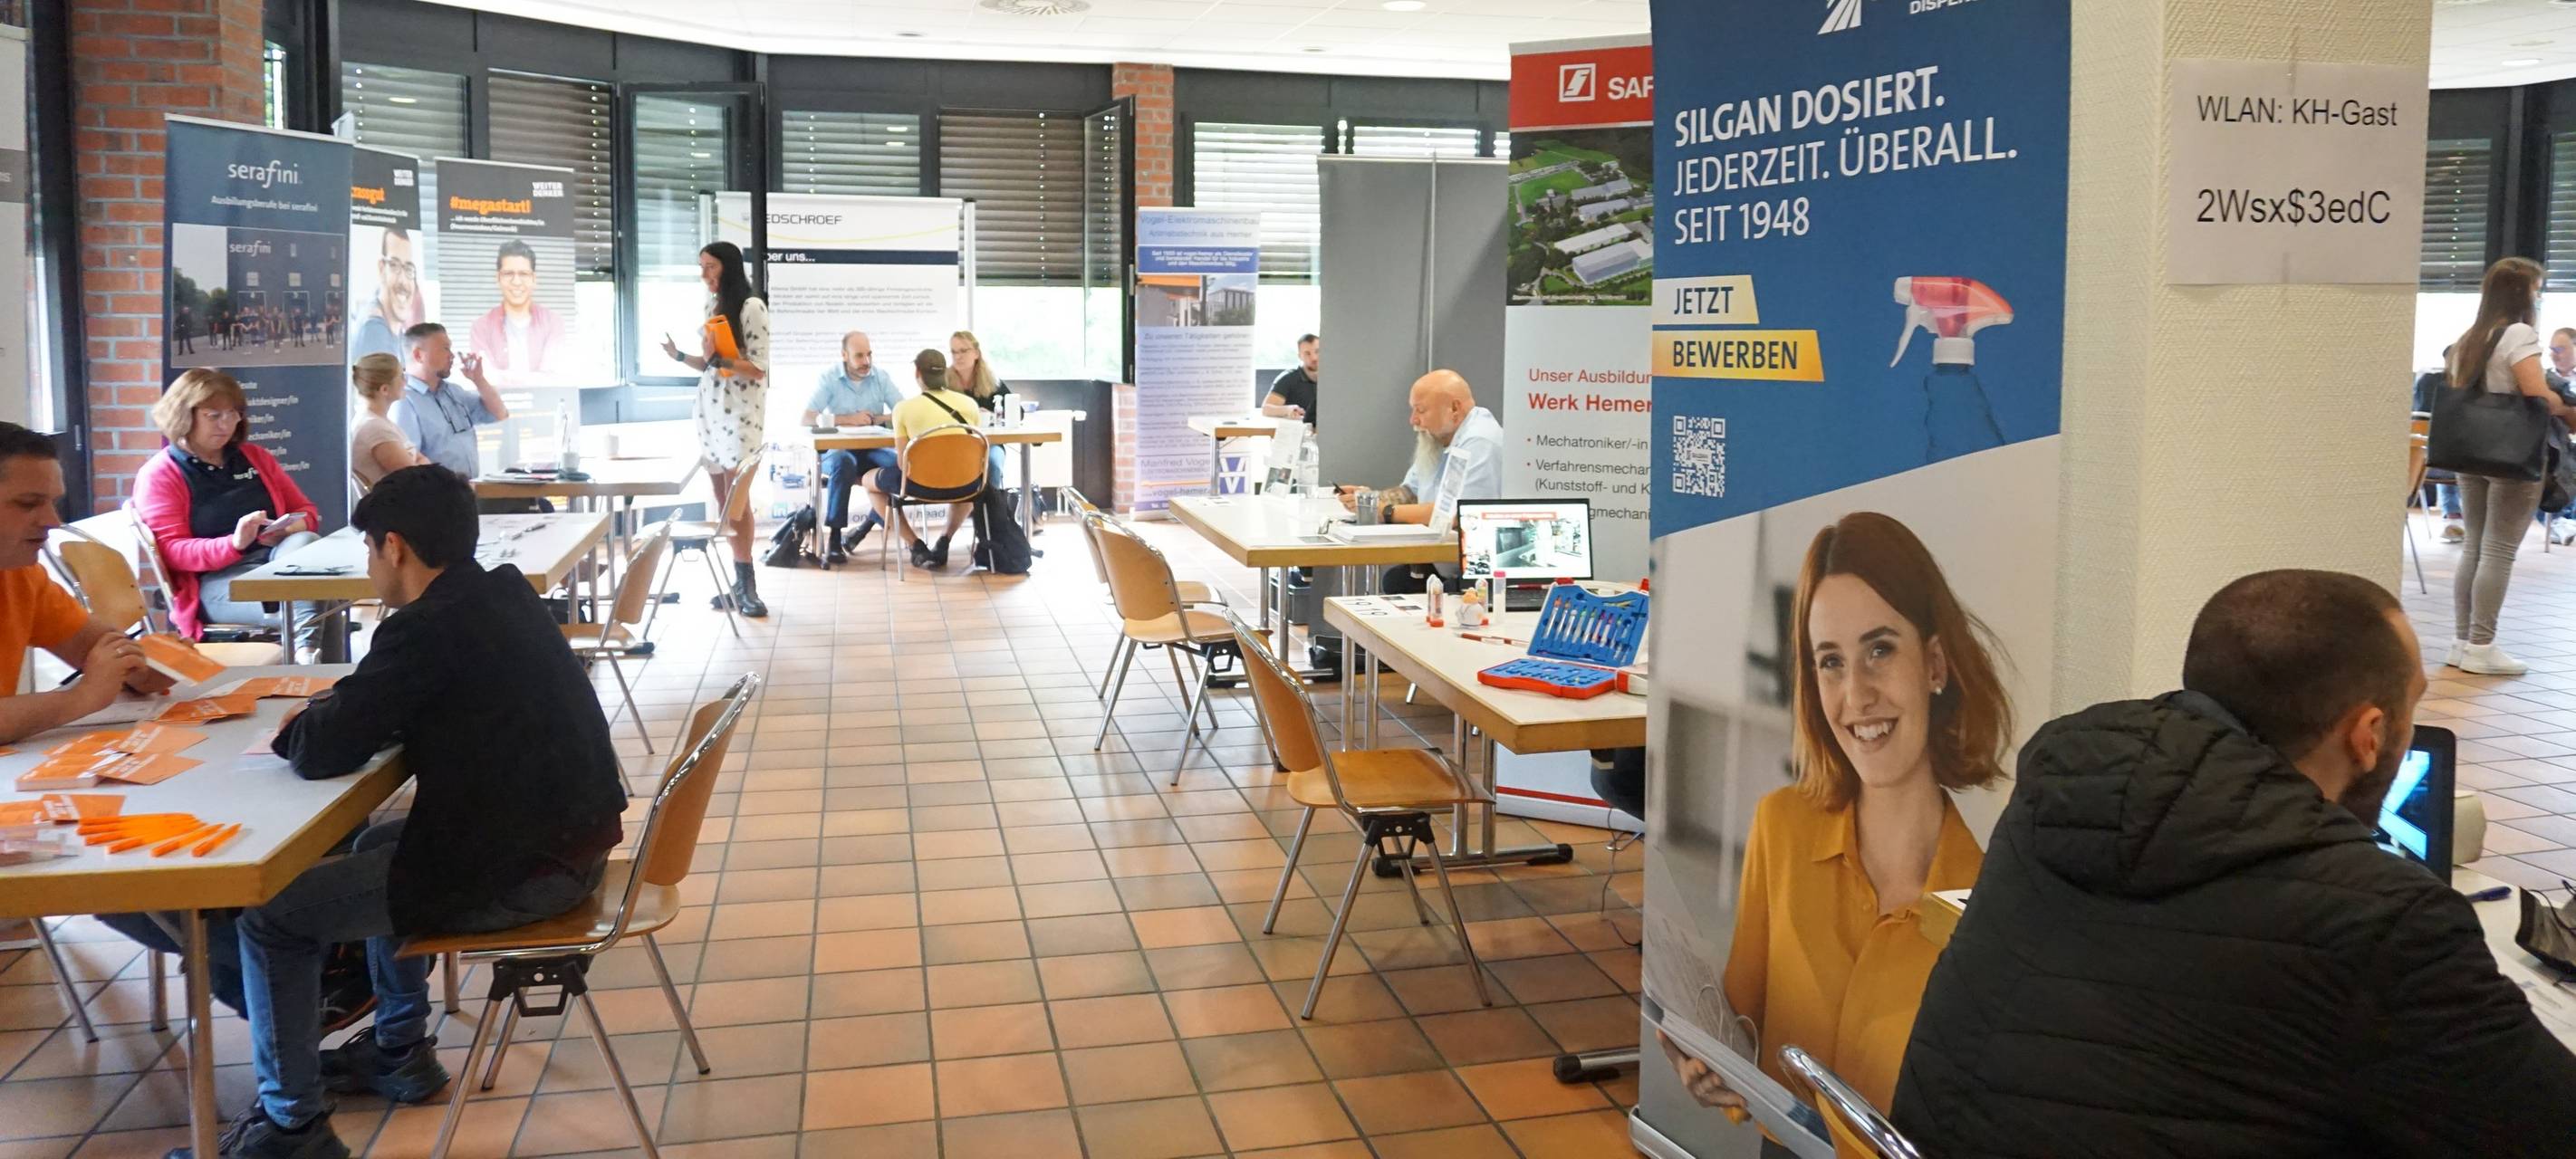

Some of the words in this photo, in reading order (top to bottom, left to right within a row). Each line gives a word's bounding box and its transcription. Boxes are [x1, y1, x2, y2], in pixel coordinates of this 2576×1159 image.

[1675, 95, 1782, 148] SILGAN
[1792, 66, 1946, 129] DOSIERT.
[2197, 95, 2283, 124] WLAN:
[2292, 99, 2398, 126] KH-Gast
[1674, 140, 1831, 196] JEDERZEIT.
[1840, 116, 2018, 177] ÜBERALL.
[227, 159, 298, 188] serafini
[1674, 205, 1732, 244] SEIT
[1739, 196, 1811, 240] 1948
[2196, 187, 2391, 227] 2Wsx$3edC
[229, 240, 271, 257] serafini
[1674, 286, 1734, 314] JETZT
[1673, 340, 1798, 369] BEWERBEN
[1529, 369, 1573, 383] Unser
[1528, 392, 1579, 411] Werk
[1586, 394, 1652, 413] Hemer
[1536, 435, 1648, 450] Mechatroniker/-in
[1535, 478, 1609, 493] (Kunststoff-
[1612, 483, 1637, 494] und
